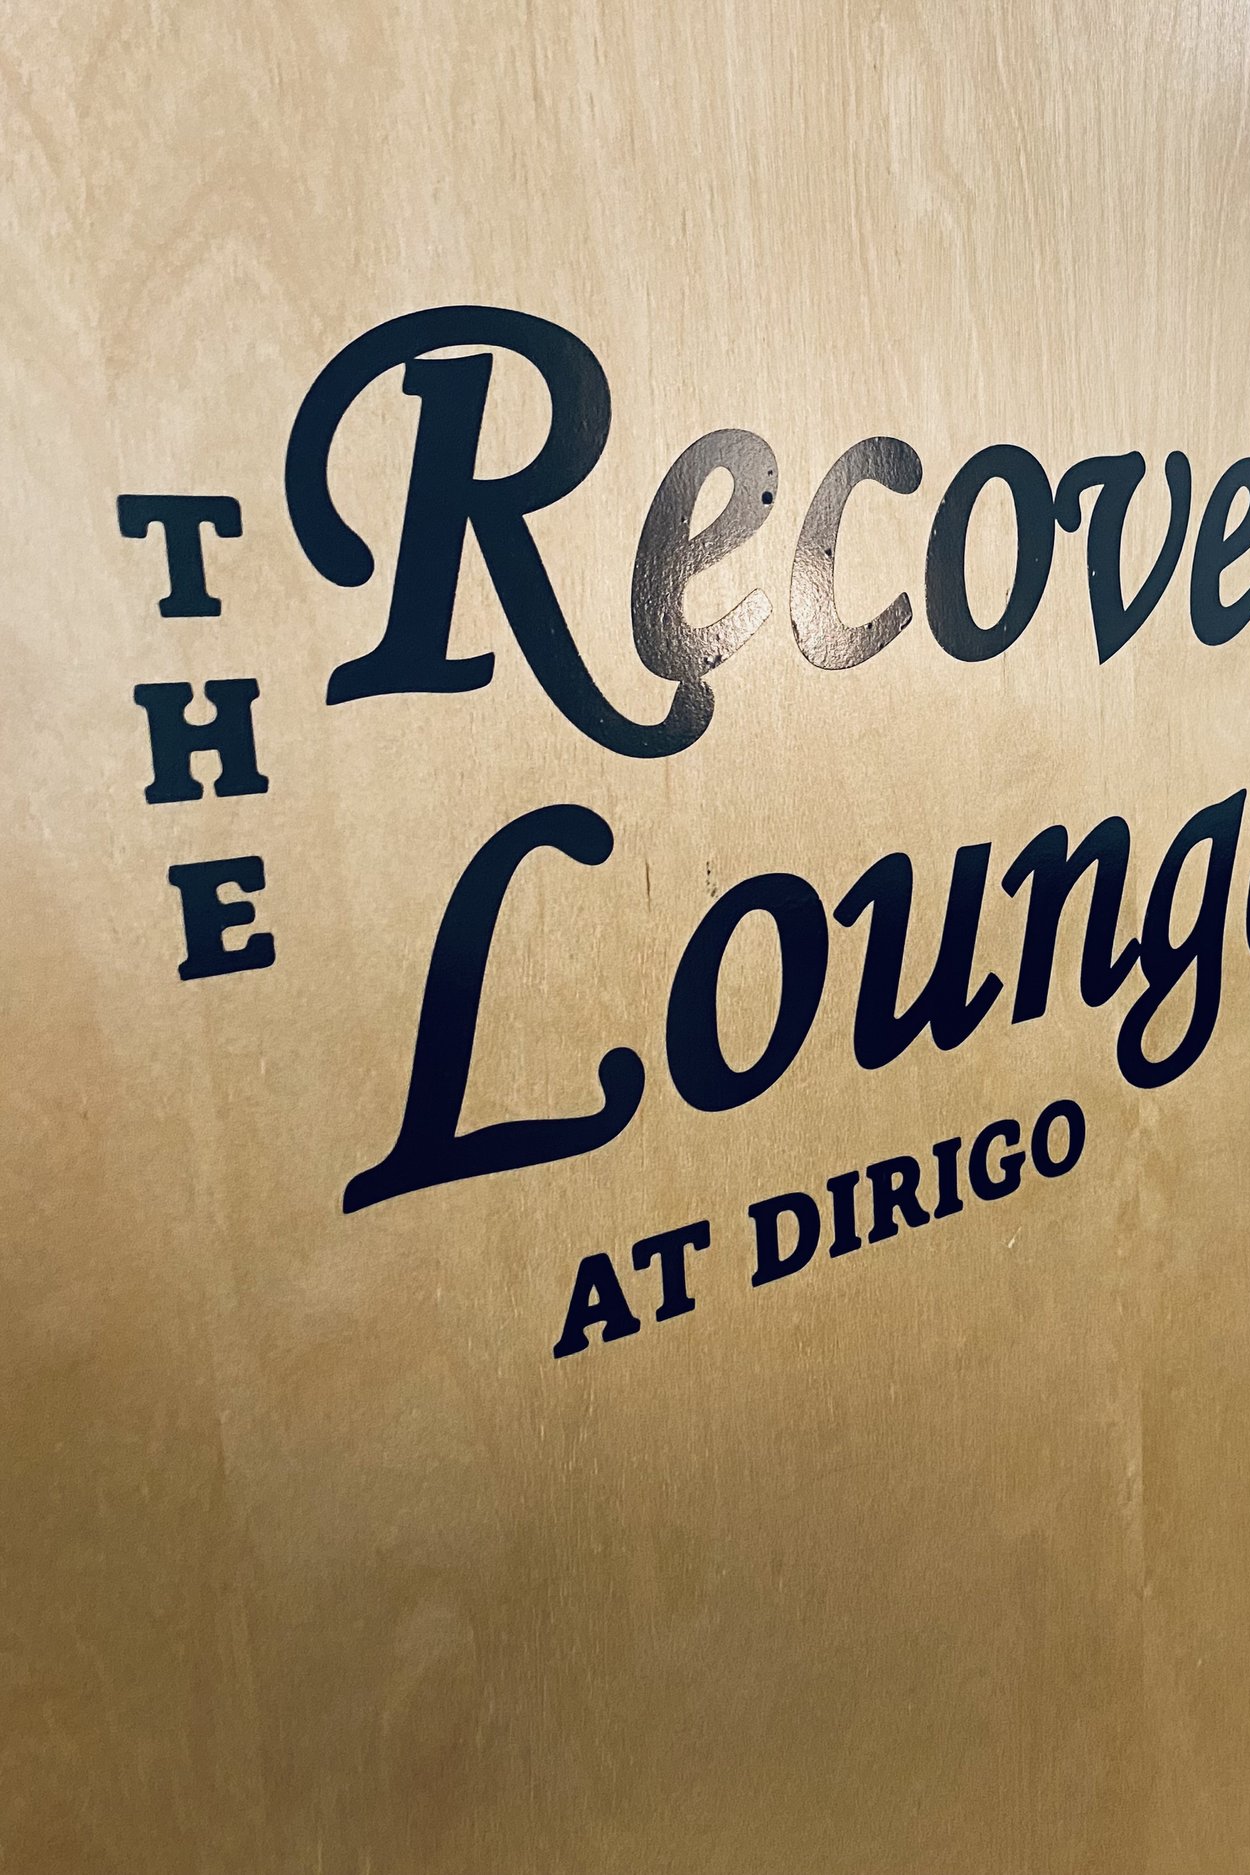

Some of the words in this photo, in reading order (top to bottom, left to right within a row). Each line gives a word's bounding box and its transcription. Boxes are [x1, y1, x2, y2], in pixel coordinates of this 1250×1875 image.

[116, 494, 276, 982] THE
[552, 1219, 711, 1360] AT
[747, 1099, 1086, 1289] DIRIGO
